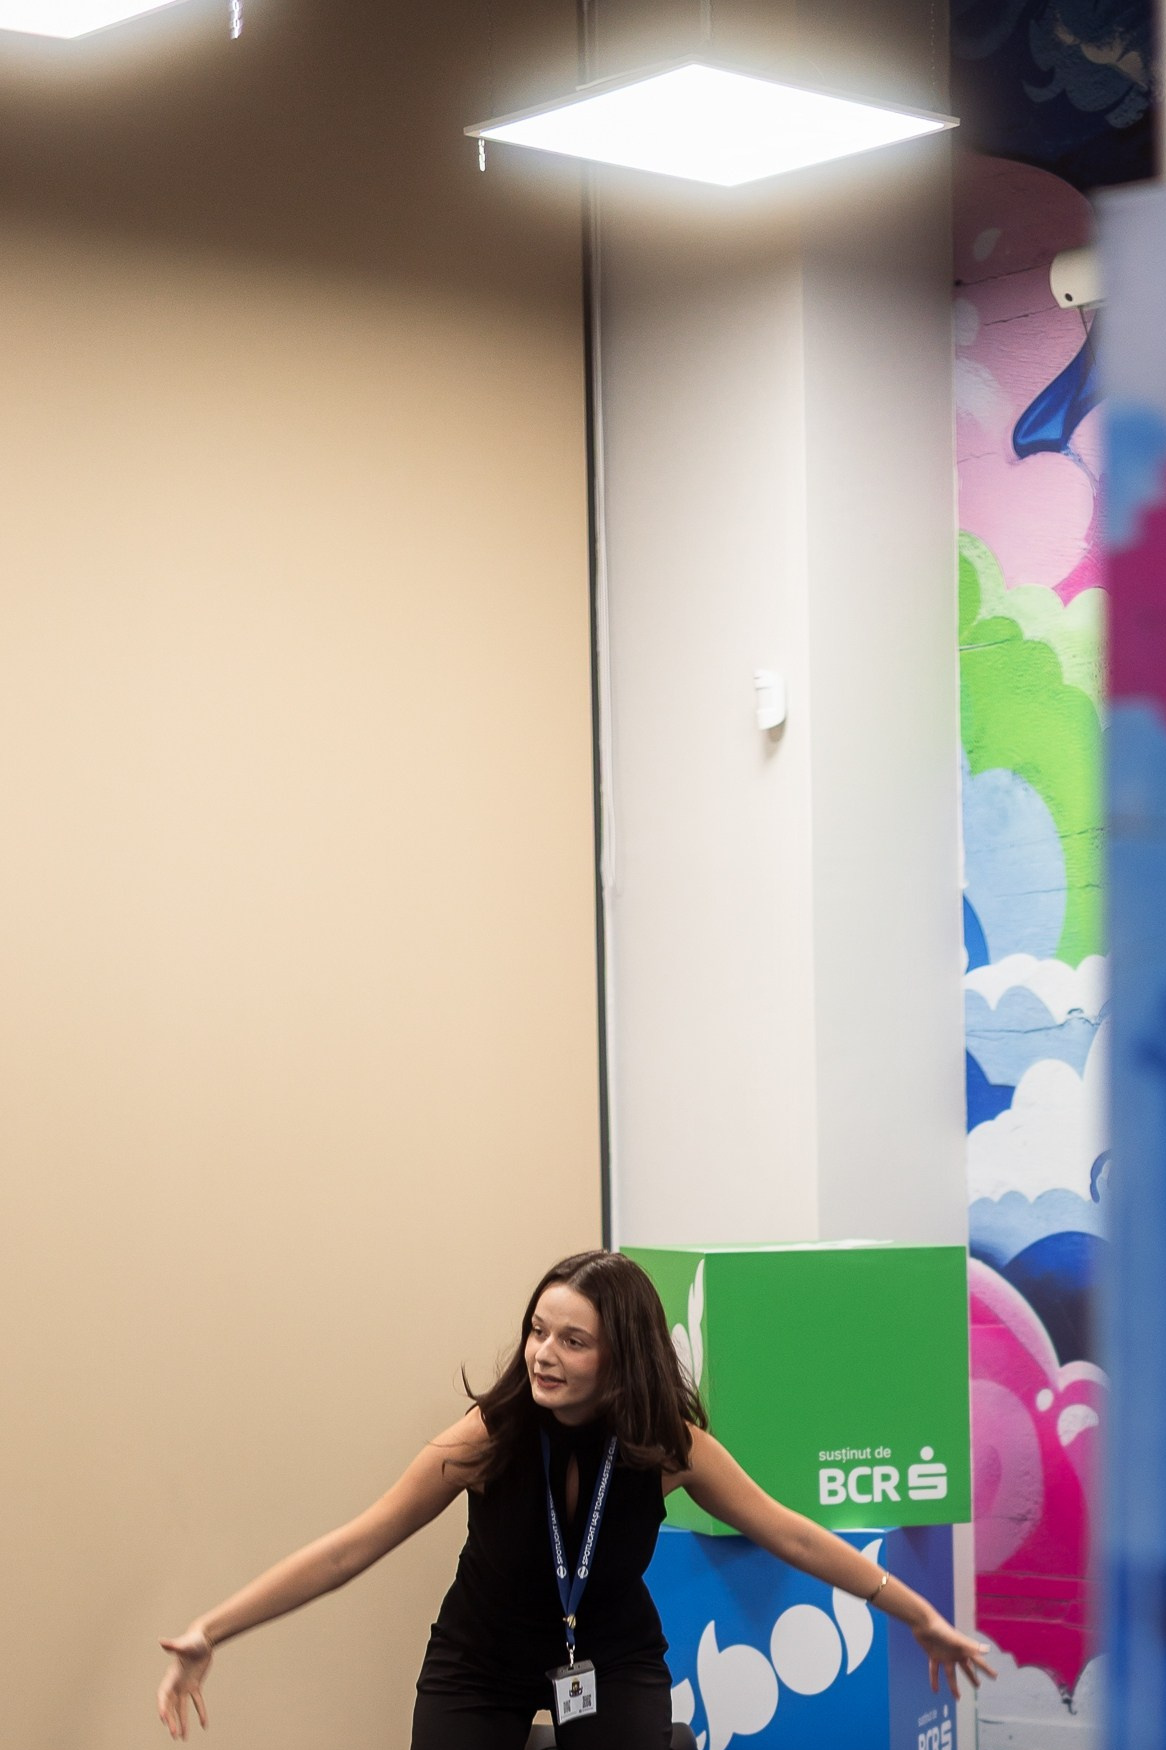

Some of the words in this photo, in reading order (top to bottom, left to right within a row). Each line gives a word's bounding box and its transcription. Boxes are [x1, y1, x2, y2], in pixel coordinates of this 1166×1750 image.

[874, 1445, 892, 1459] de
[818, 1465, 902, 1505] BCR
[582, 1526, 596, 1566] SPOTLIGHT
